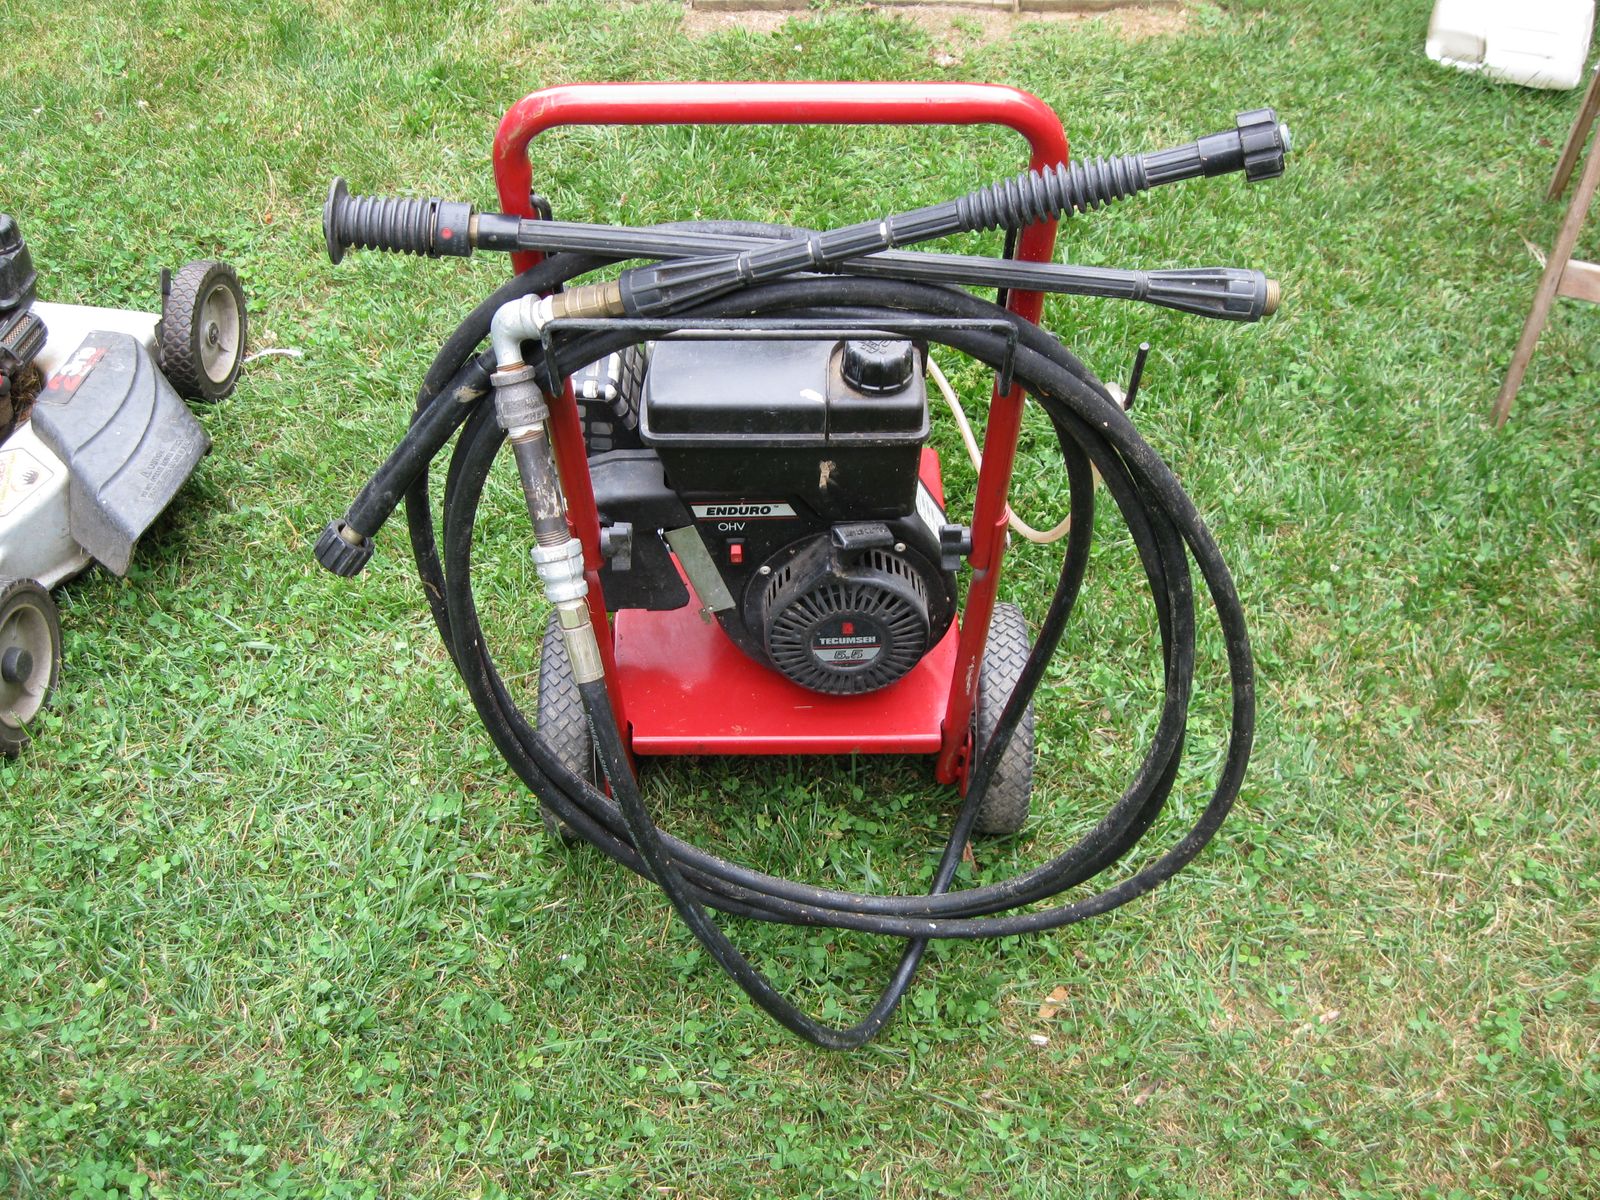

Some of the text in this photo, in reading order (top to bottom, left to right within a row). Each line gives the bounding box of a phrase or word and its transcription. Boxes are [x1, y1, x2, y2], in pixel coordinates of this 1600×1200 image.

[706, 506, 771, 516] ENDURO
[718, 522, 746, 531] OHV
[819, 636, 876, 645] TECUMSEH
[834, 649, 863, 660] 5.5
